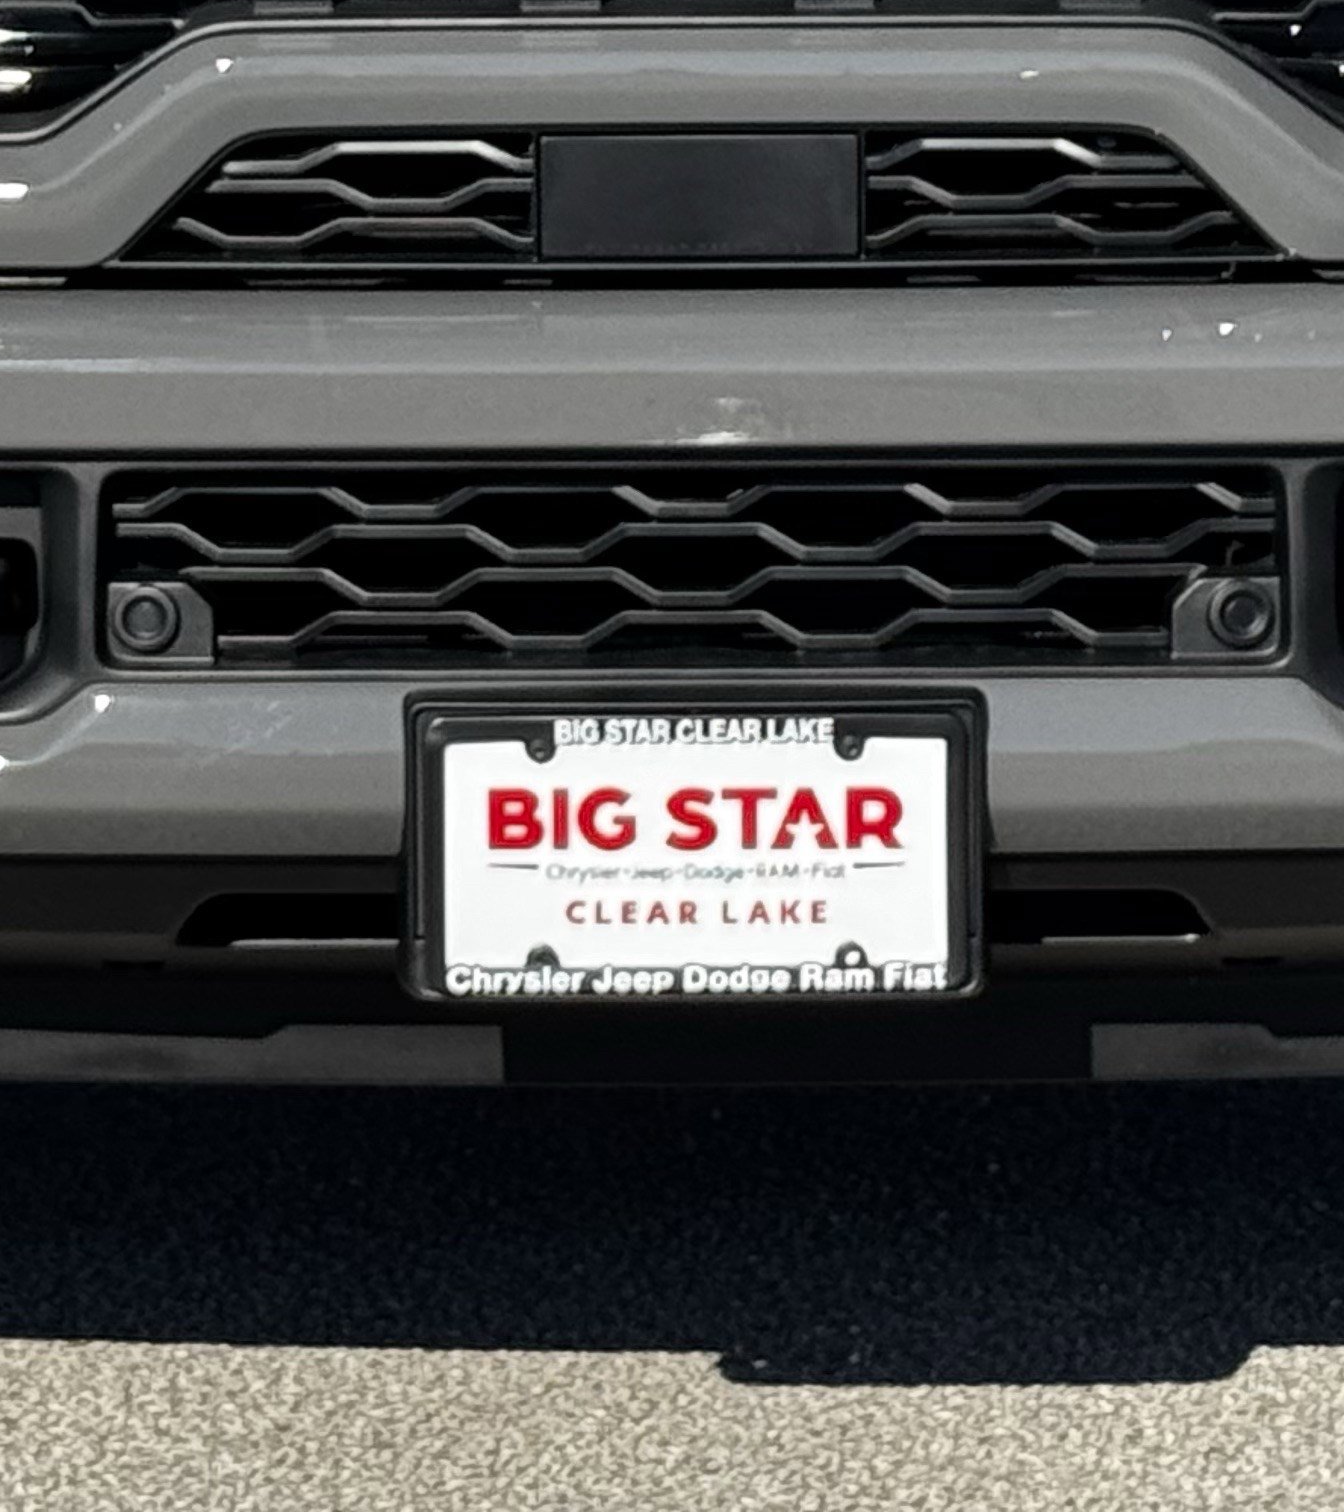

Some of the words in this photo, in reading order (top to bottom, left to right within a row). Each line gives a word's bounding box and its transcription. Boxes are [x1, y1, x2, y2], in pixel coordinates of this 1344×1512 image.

[554, 718, 600, 744] BIG
[604, 718, 671, 745] STAR
[674, 718, 762, 744] CLEAR
[765, 717, 835, 744] LAKE
[488, 788, 637, 850] BIG
[666, 788, 904, 851] STAR
[565, 899, 698, 925] CLEAR
[722, 899, 827, 925] LAKE
[446, 964, 586, 996] Chrysler
[591, 966, 675, 996] Jeep
[682, 964, 791, 994] Dodge
[799, 963, 875, 992] Ram
[883, 961, 947, 992] Fiat
